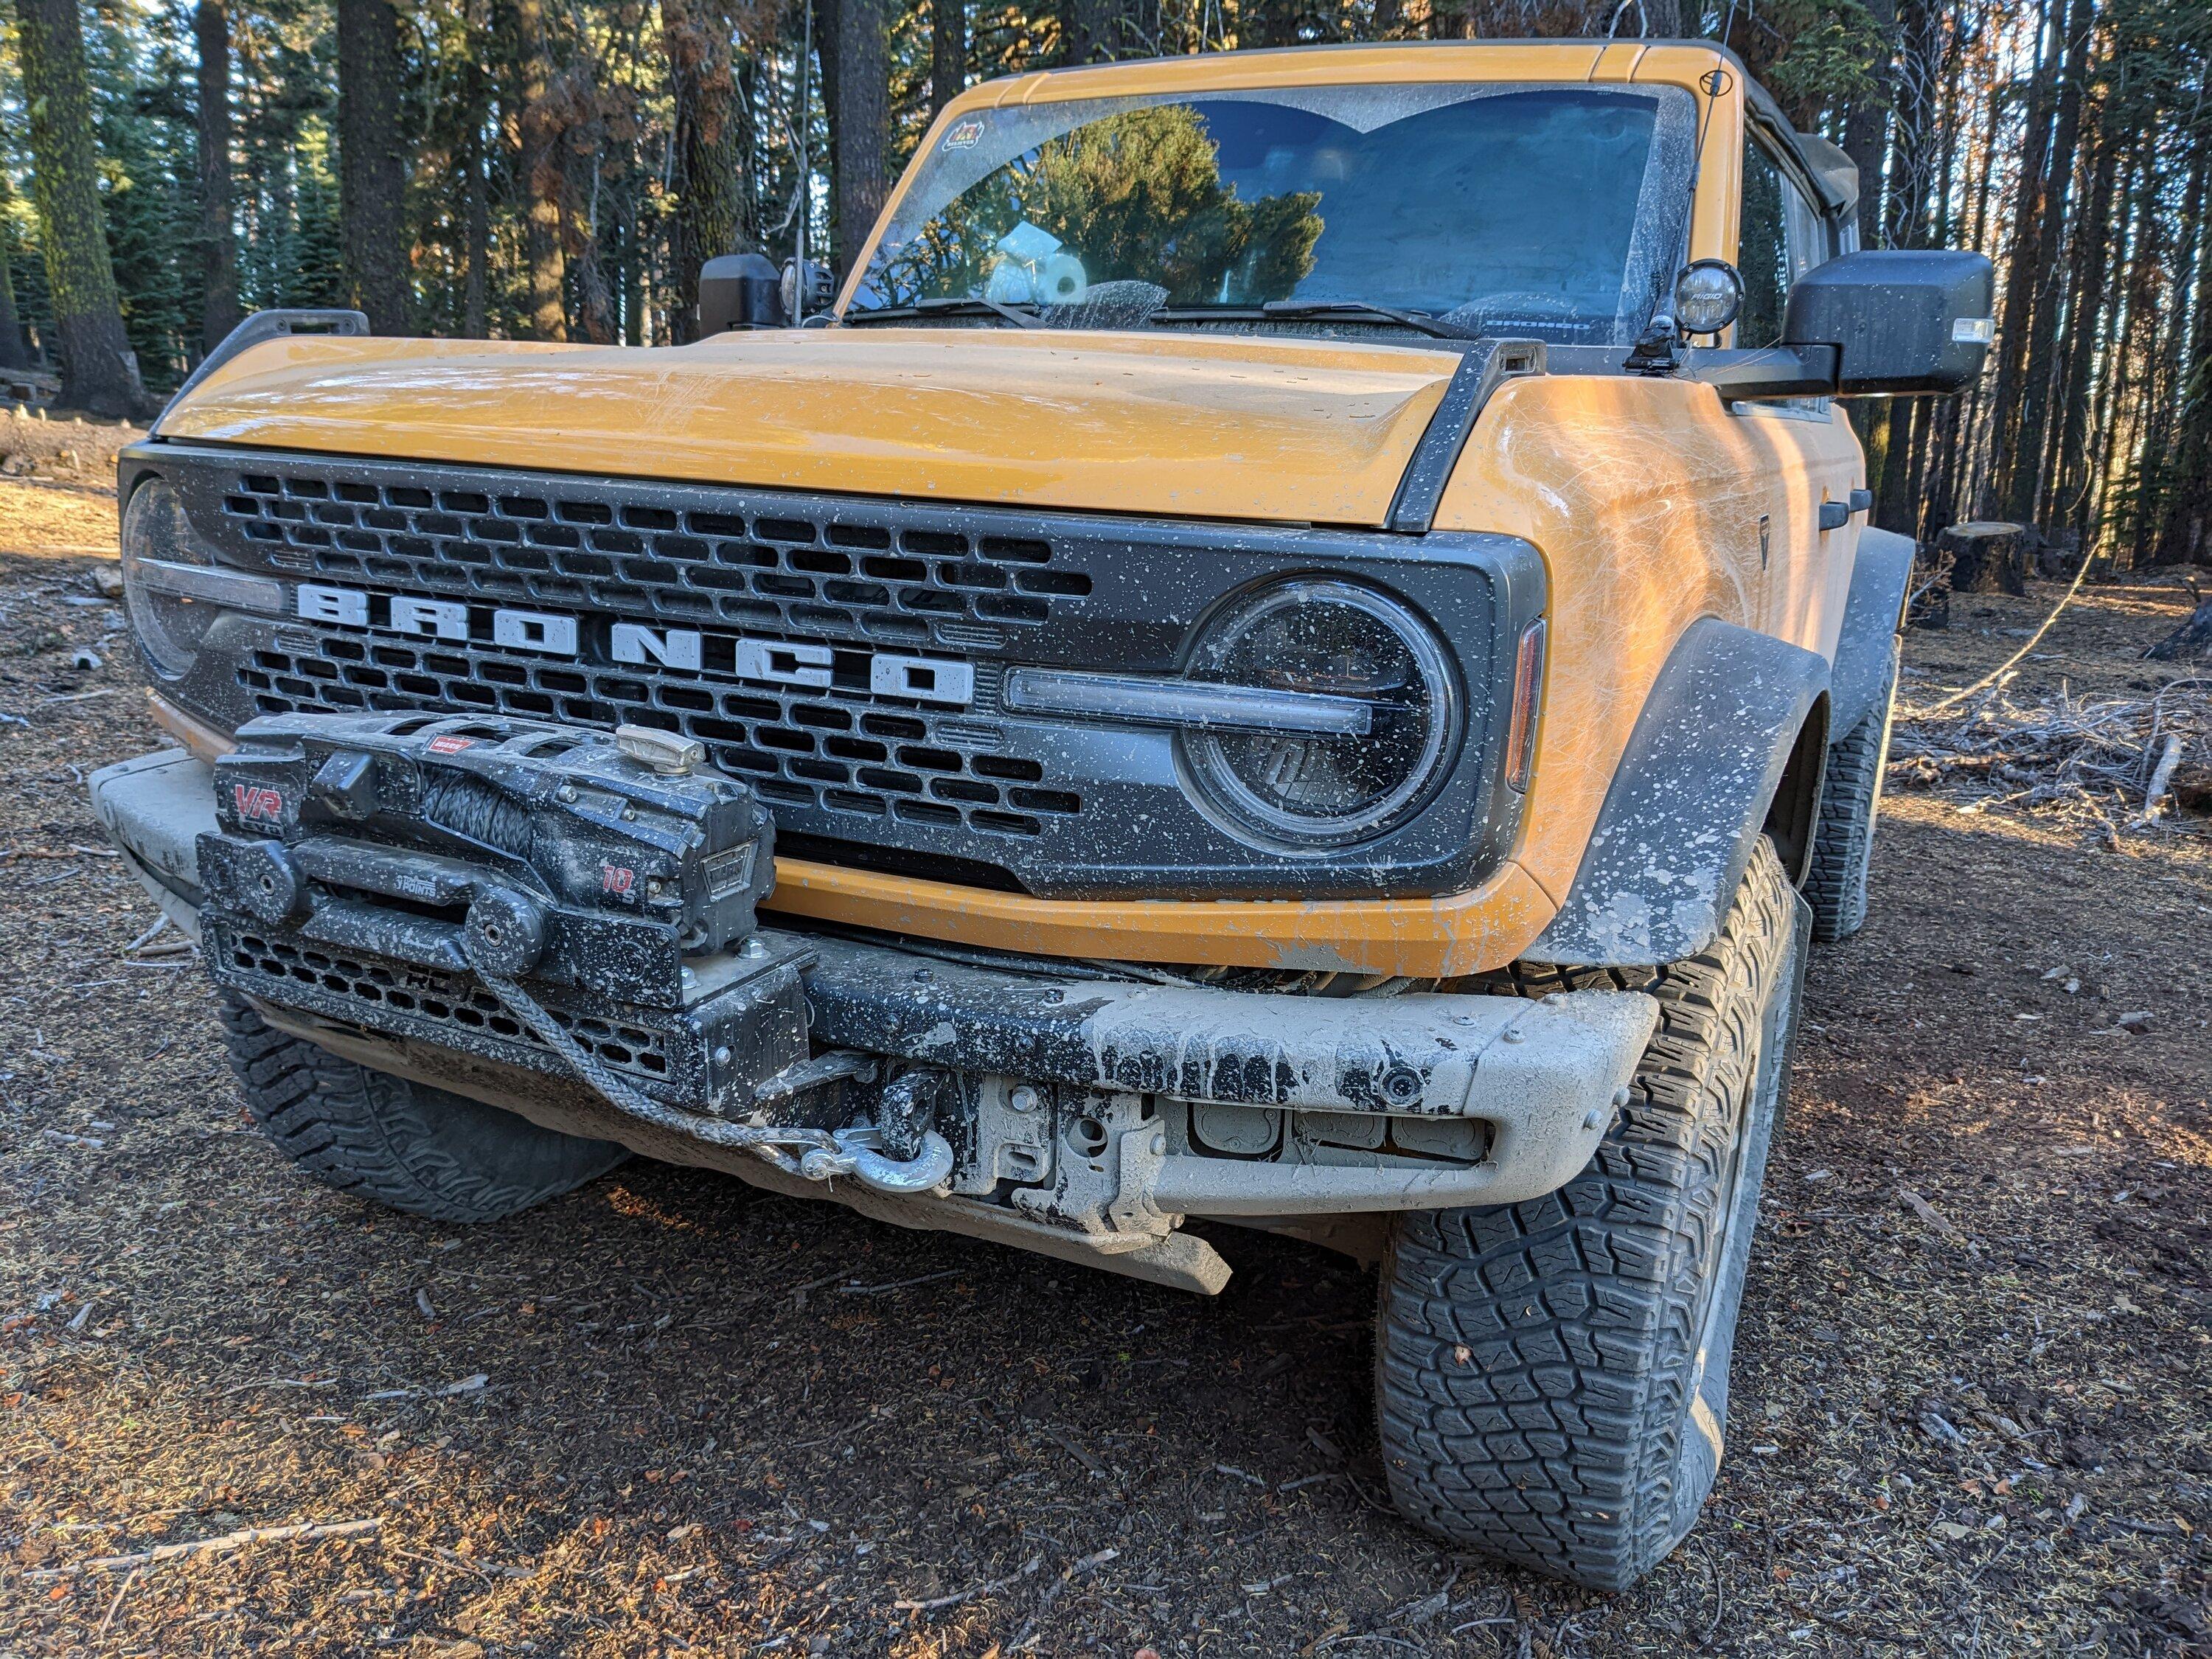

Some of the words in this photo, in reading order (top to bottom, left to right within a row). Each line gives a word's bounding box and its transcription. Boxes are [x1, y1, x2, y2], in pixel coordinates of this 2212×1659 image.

[1486, 320, 1590, 330] BRONCO
[296, 583, 974, 704] BRONCO
[234, 784, 283, 823] VR
[403, 881, 437, 897] POINTS
[602, 865, 634, 893] 10
